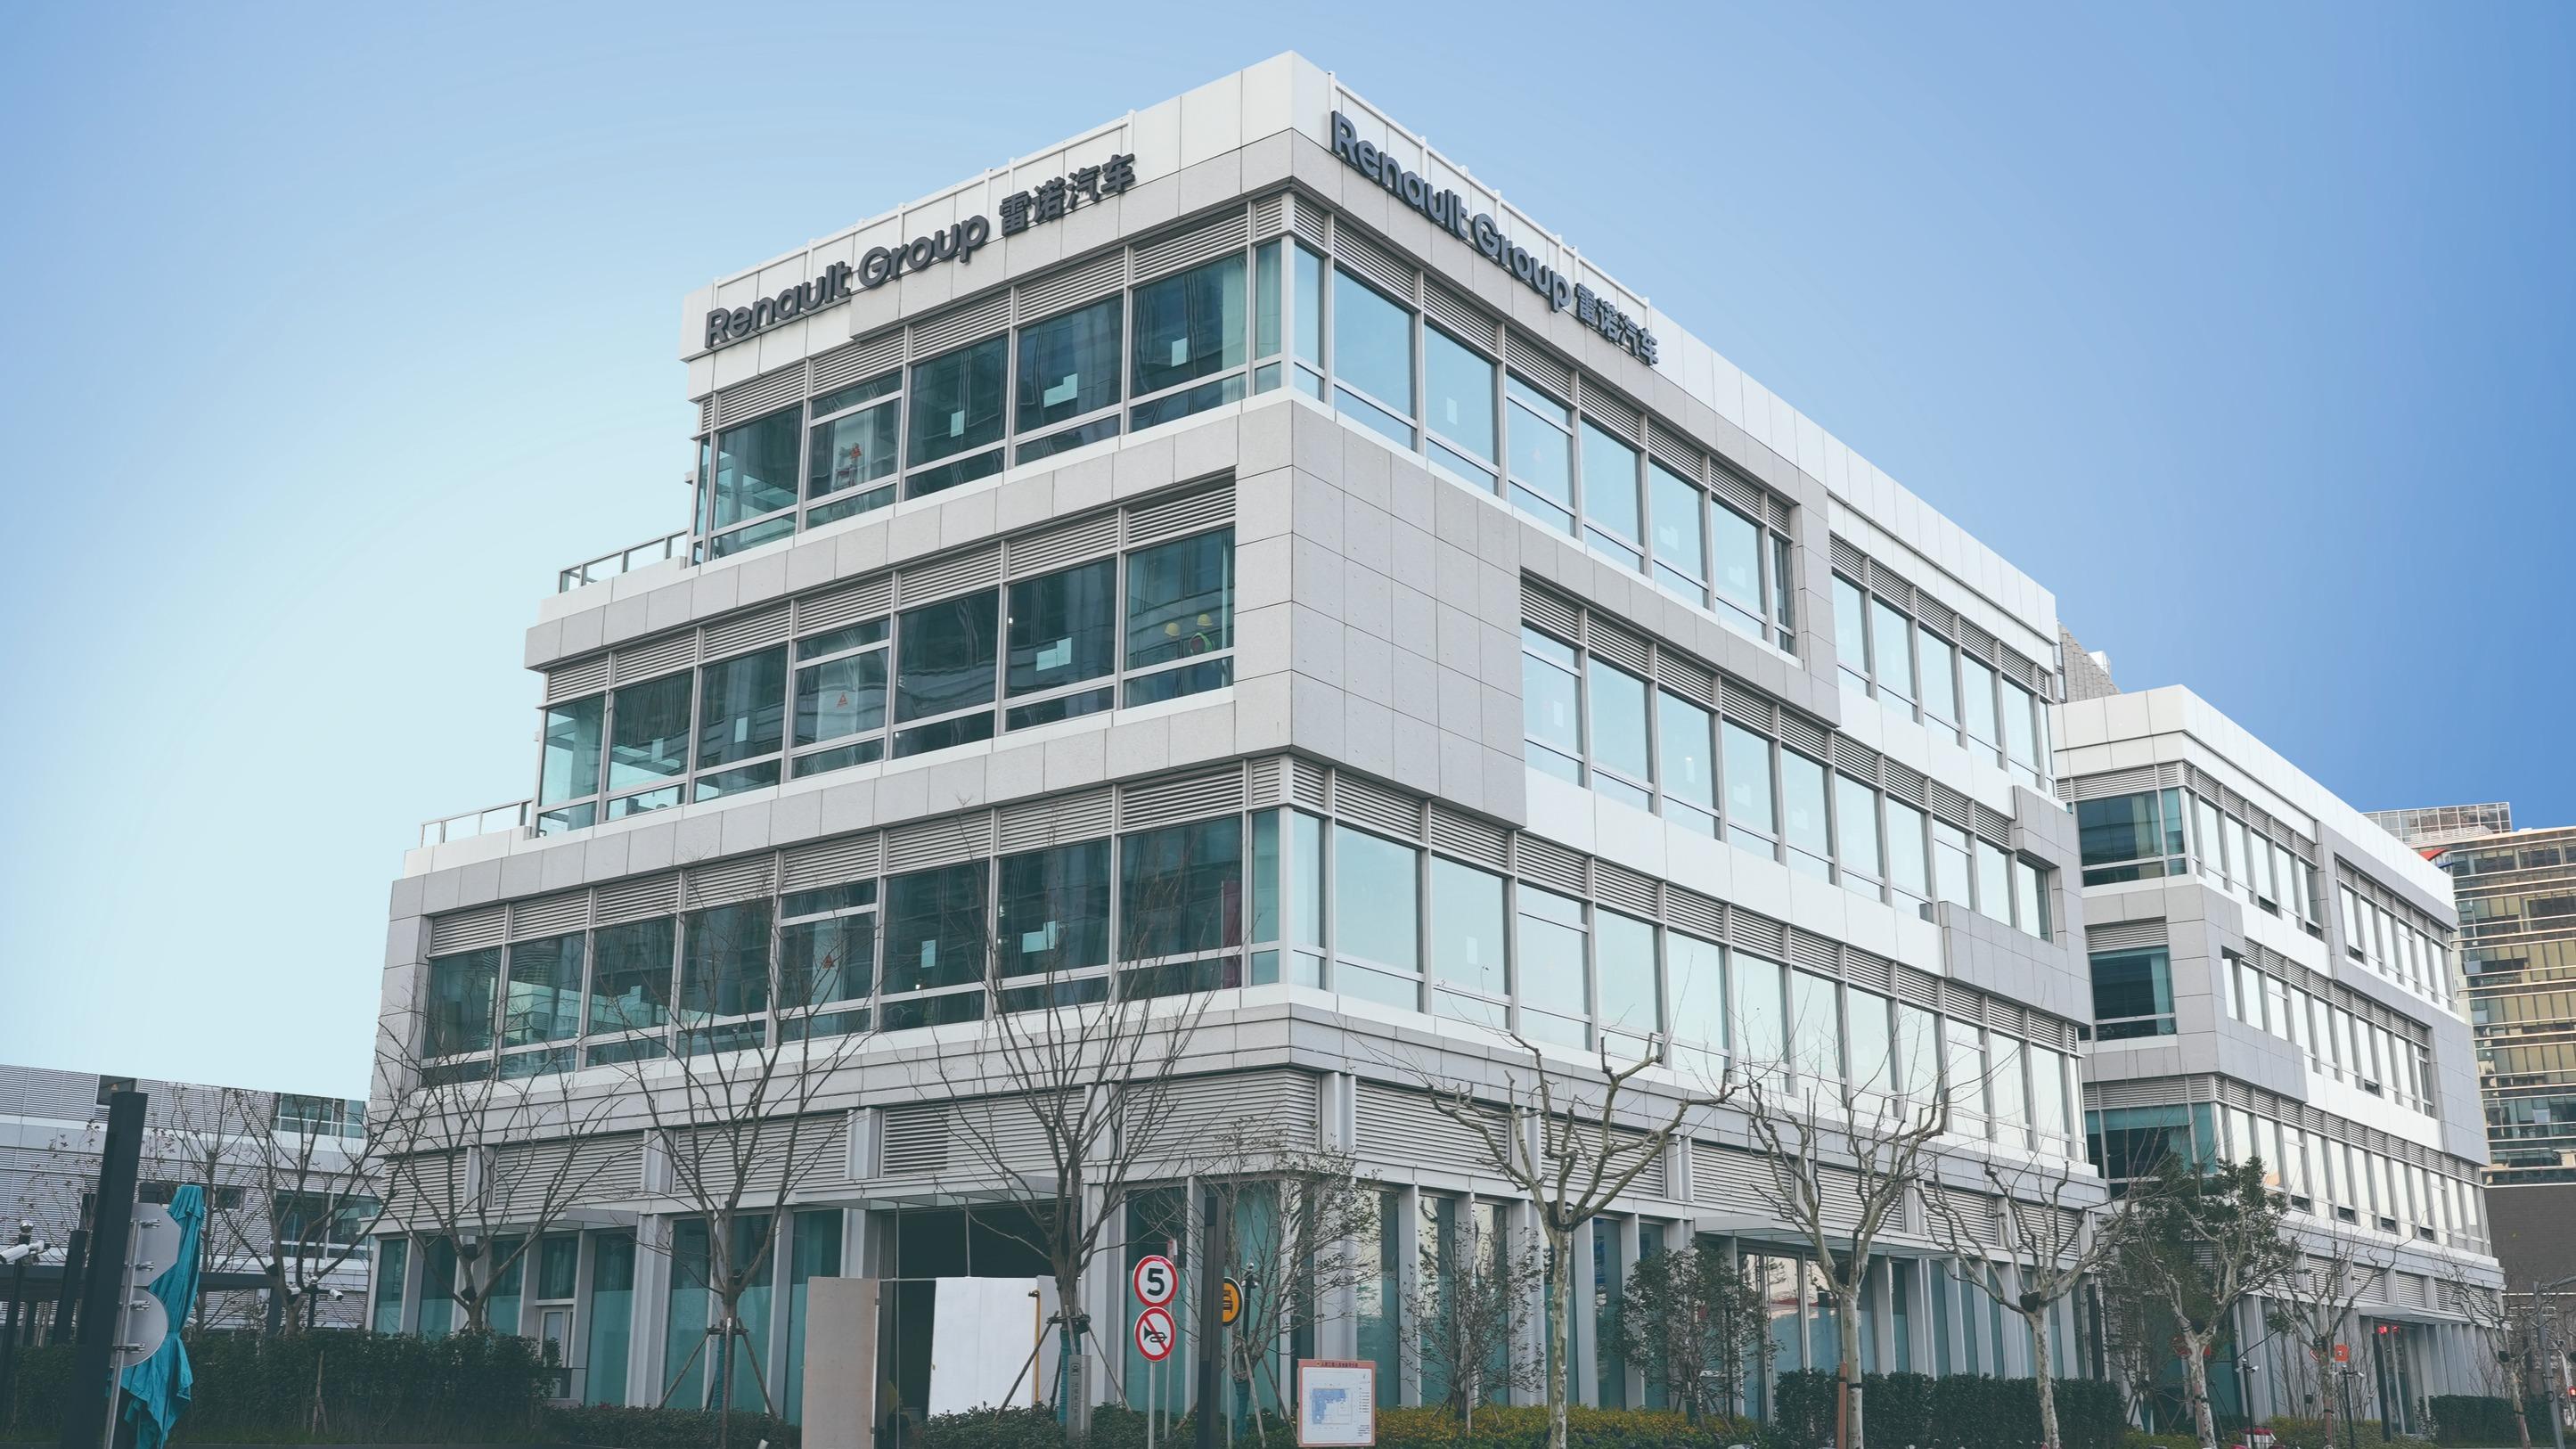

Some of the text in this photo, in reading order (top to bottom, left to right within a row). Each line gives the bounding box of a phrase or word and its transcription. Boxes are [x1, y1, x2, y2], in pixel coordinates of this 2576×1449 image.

[704, 153, 1136, 348] Renault Group 雷诺汽车
[1331, 111, 1659, 366] Renault Group 雷诺汽车
[1147, 1268, 1165, 1296] 5
